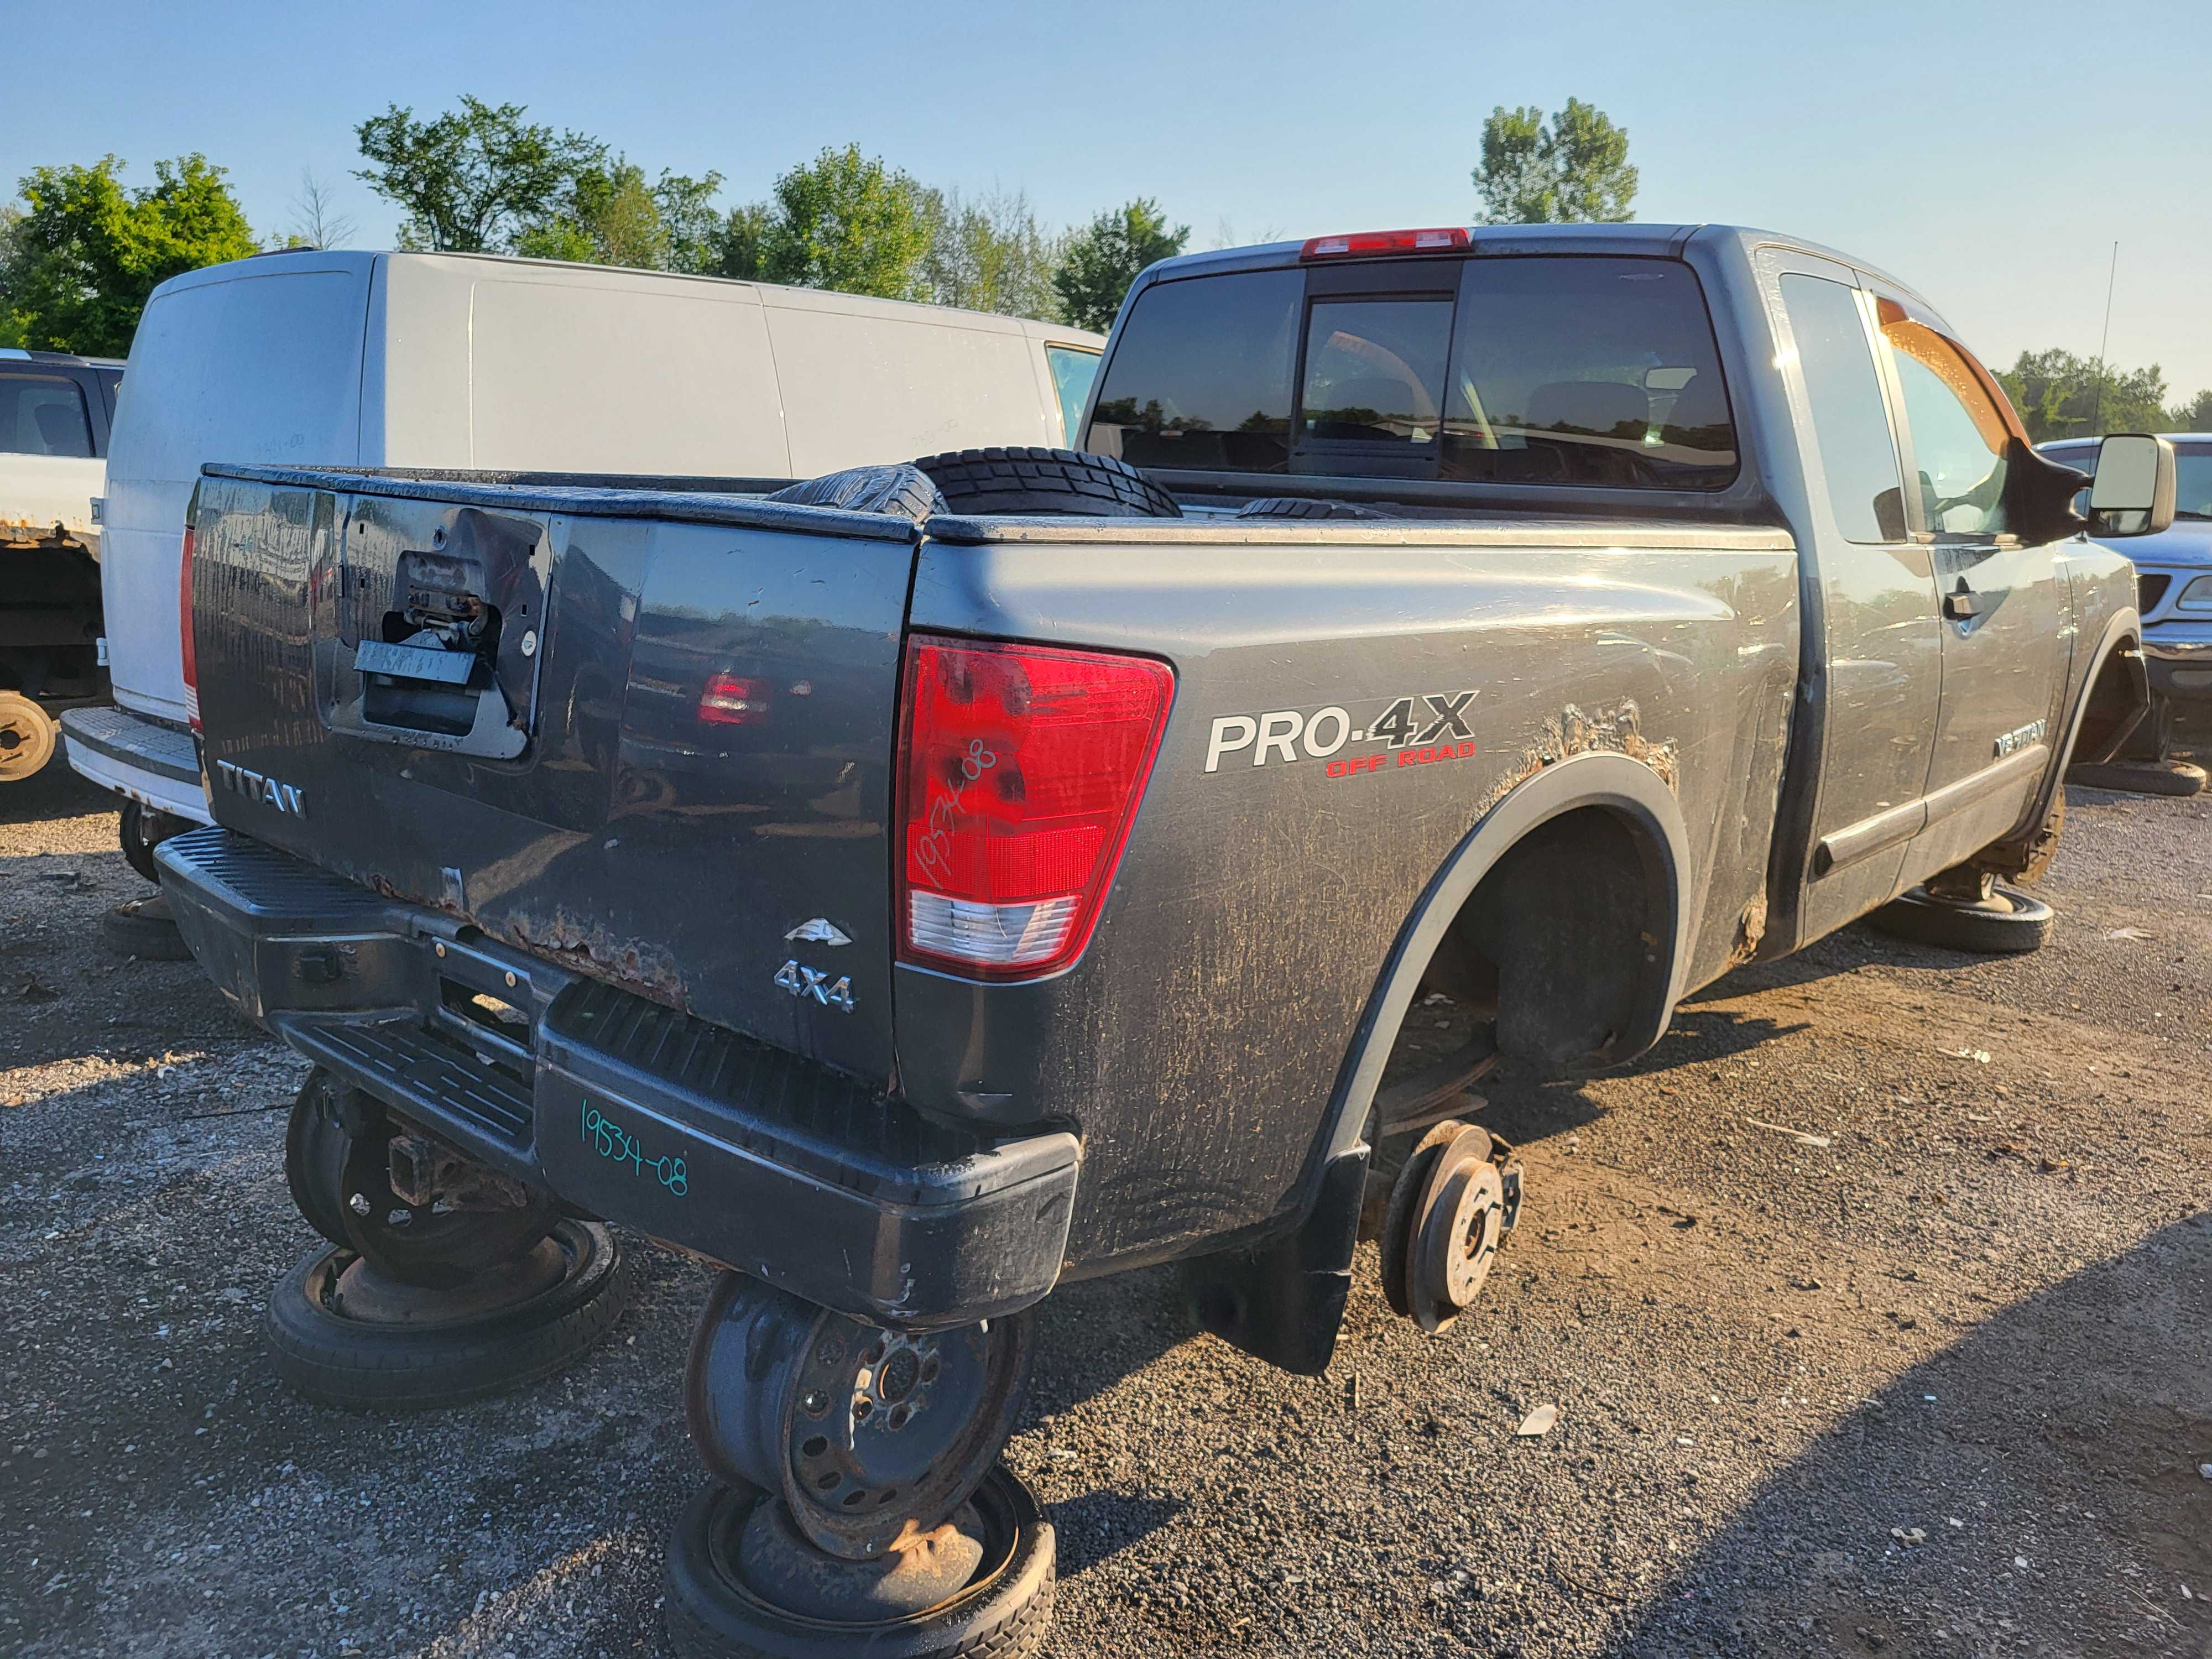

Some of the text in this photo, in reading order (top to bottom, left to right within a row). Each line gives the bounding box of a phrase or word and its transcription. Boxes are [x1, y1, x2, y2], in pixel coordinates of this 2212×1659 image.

[216, 759, 306, 819] TITAN
[1327, 742, 1475, 778] OFF ROAD
[582, 1099, 688, 1196] 19534-08
